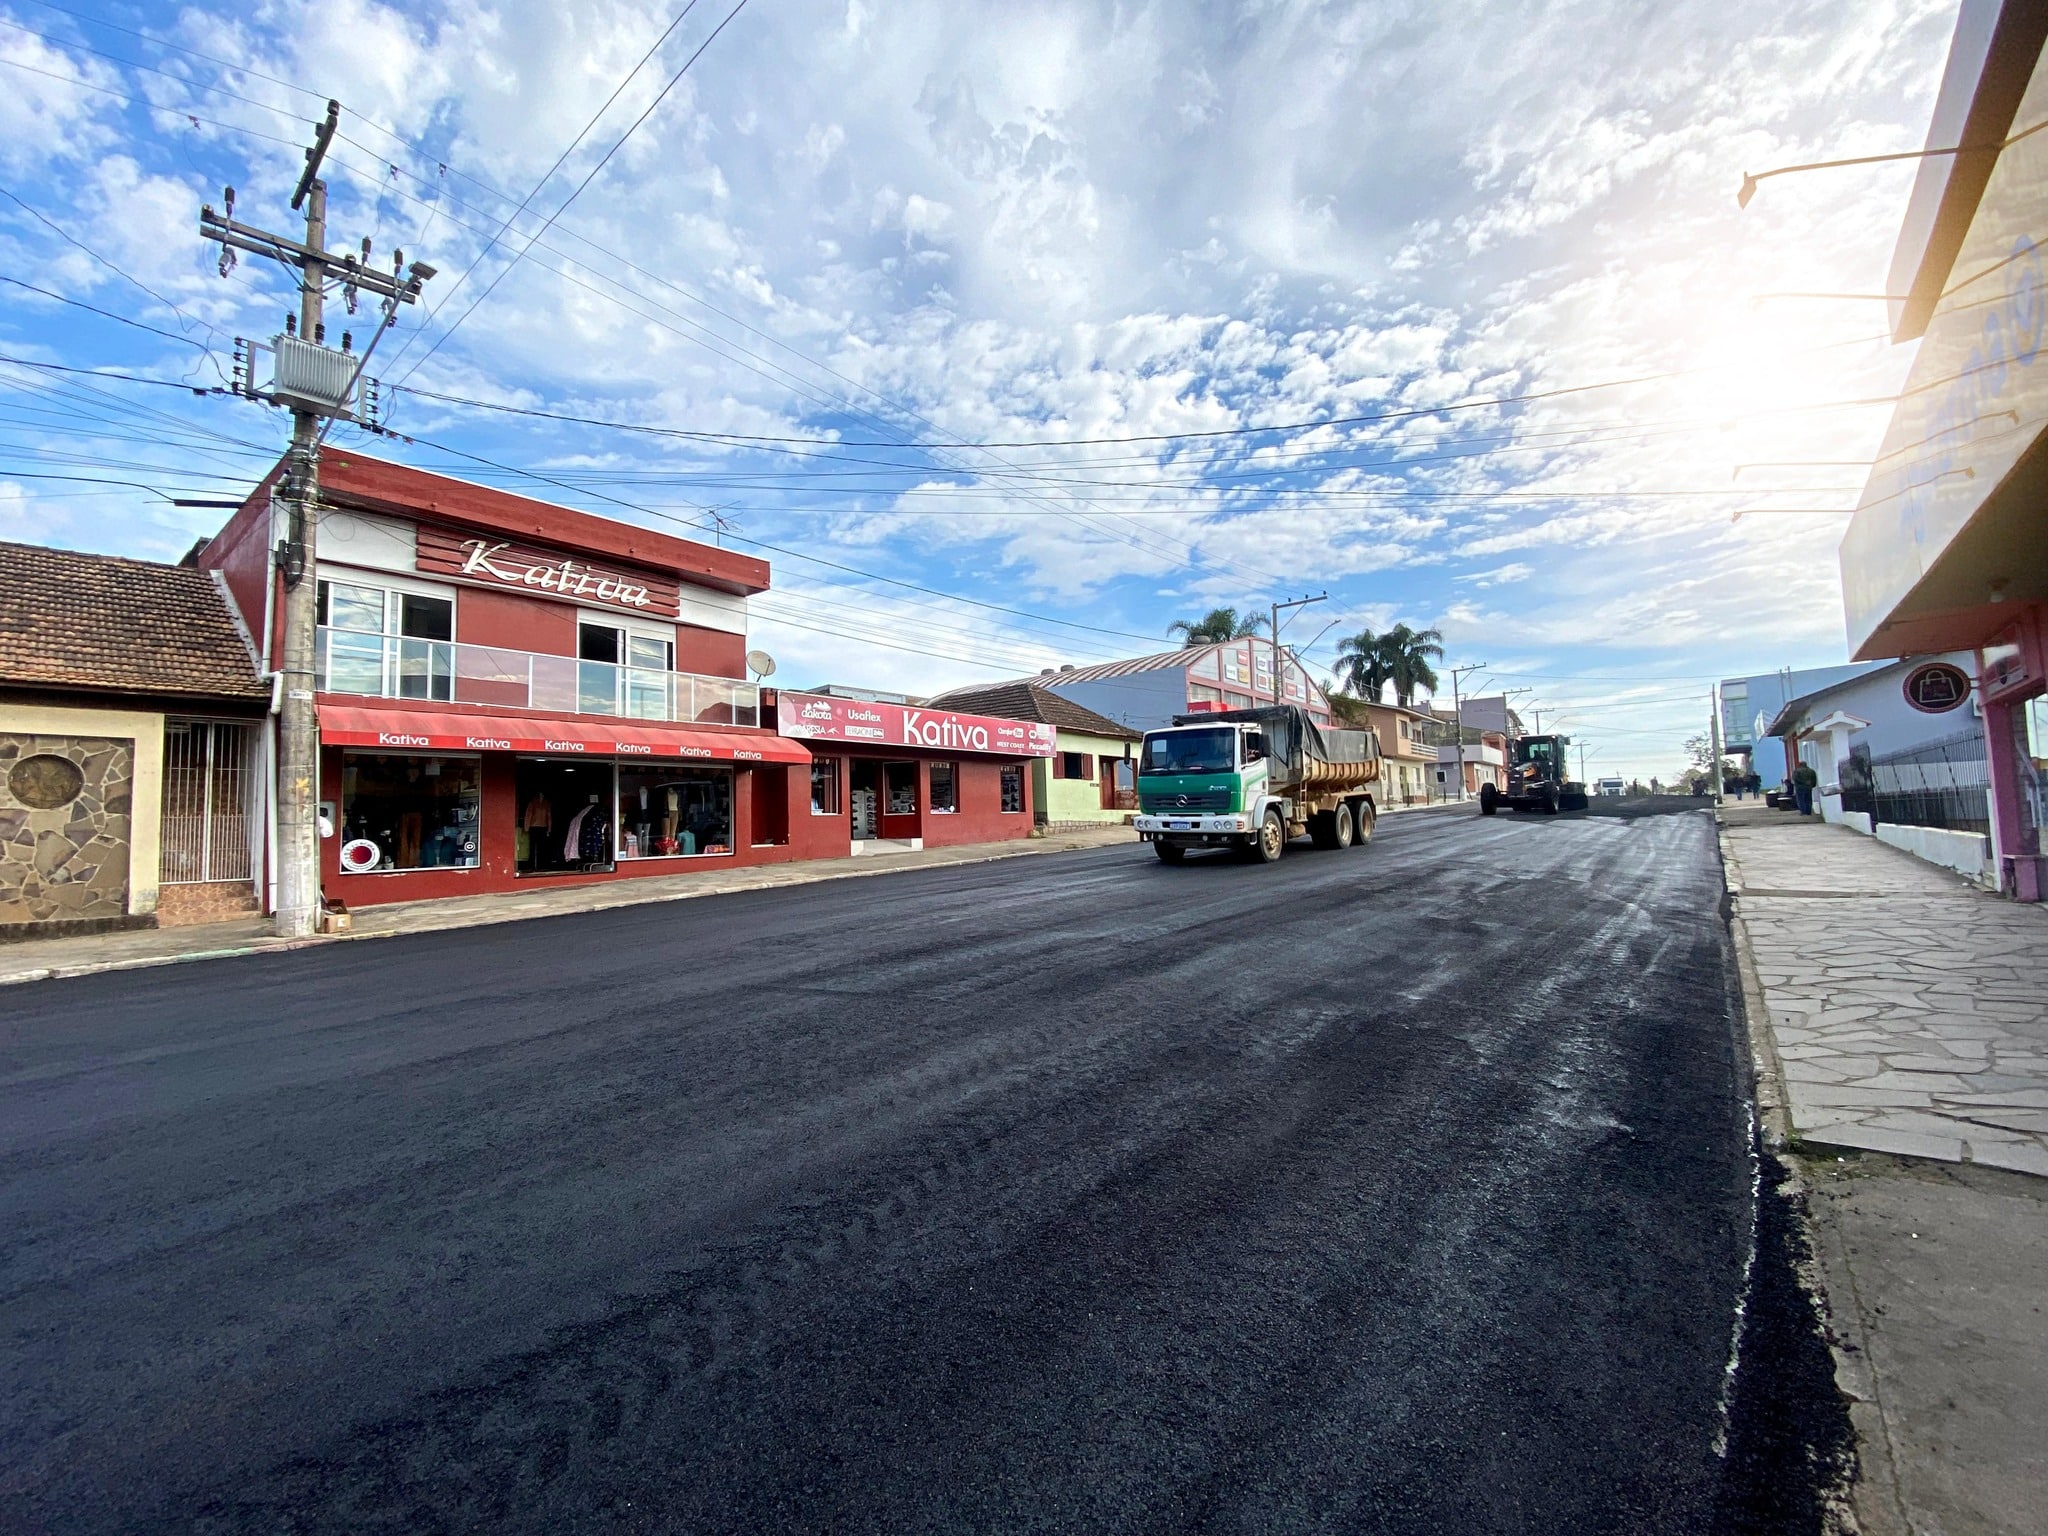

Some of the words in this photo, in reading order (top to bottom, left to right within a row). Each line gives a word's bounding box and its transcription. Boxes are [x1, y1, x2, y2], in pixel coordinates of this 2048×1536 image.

[458, 539, 651, 607] Kativa
[801, 708, 832, 721] dakota
[847, 709, 882, 722] Usaflex
[903, 711, 989, 750] Kativa
[379, 733, 430, 746] Kativa
[466, 737, 511, 749] Kativa
[545, 740, 585, 751] Kativa
[615, 742, 651, 754] Kativa
[680, 745, 711, 757] Kativa
[733, 749, 762, 760] Kativa
